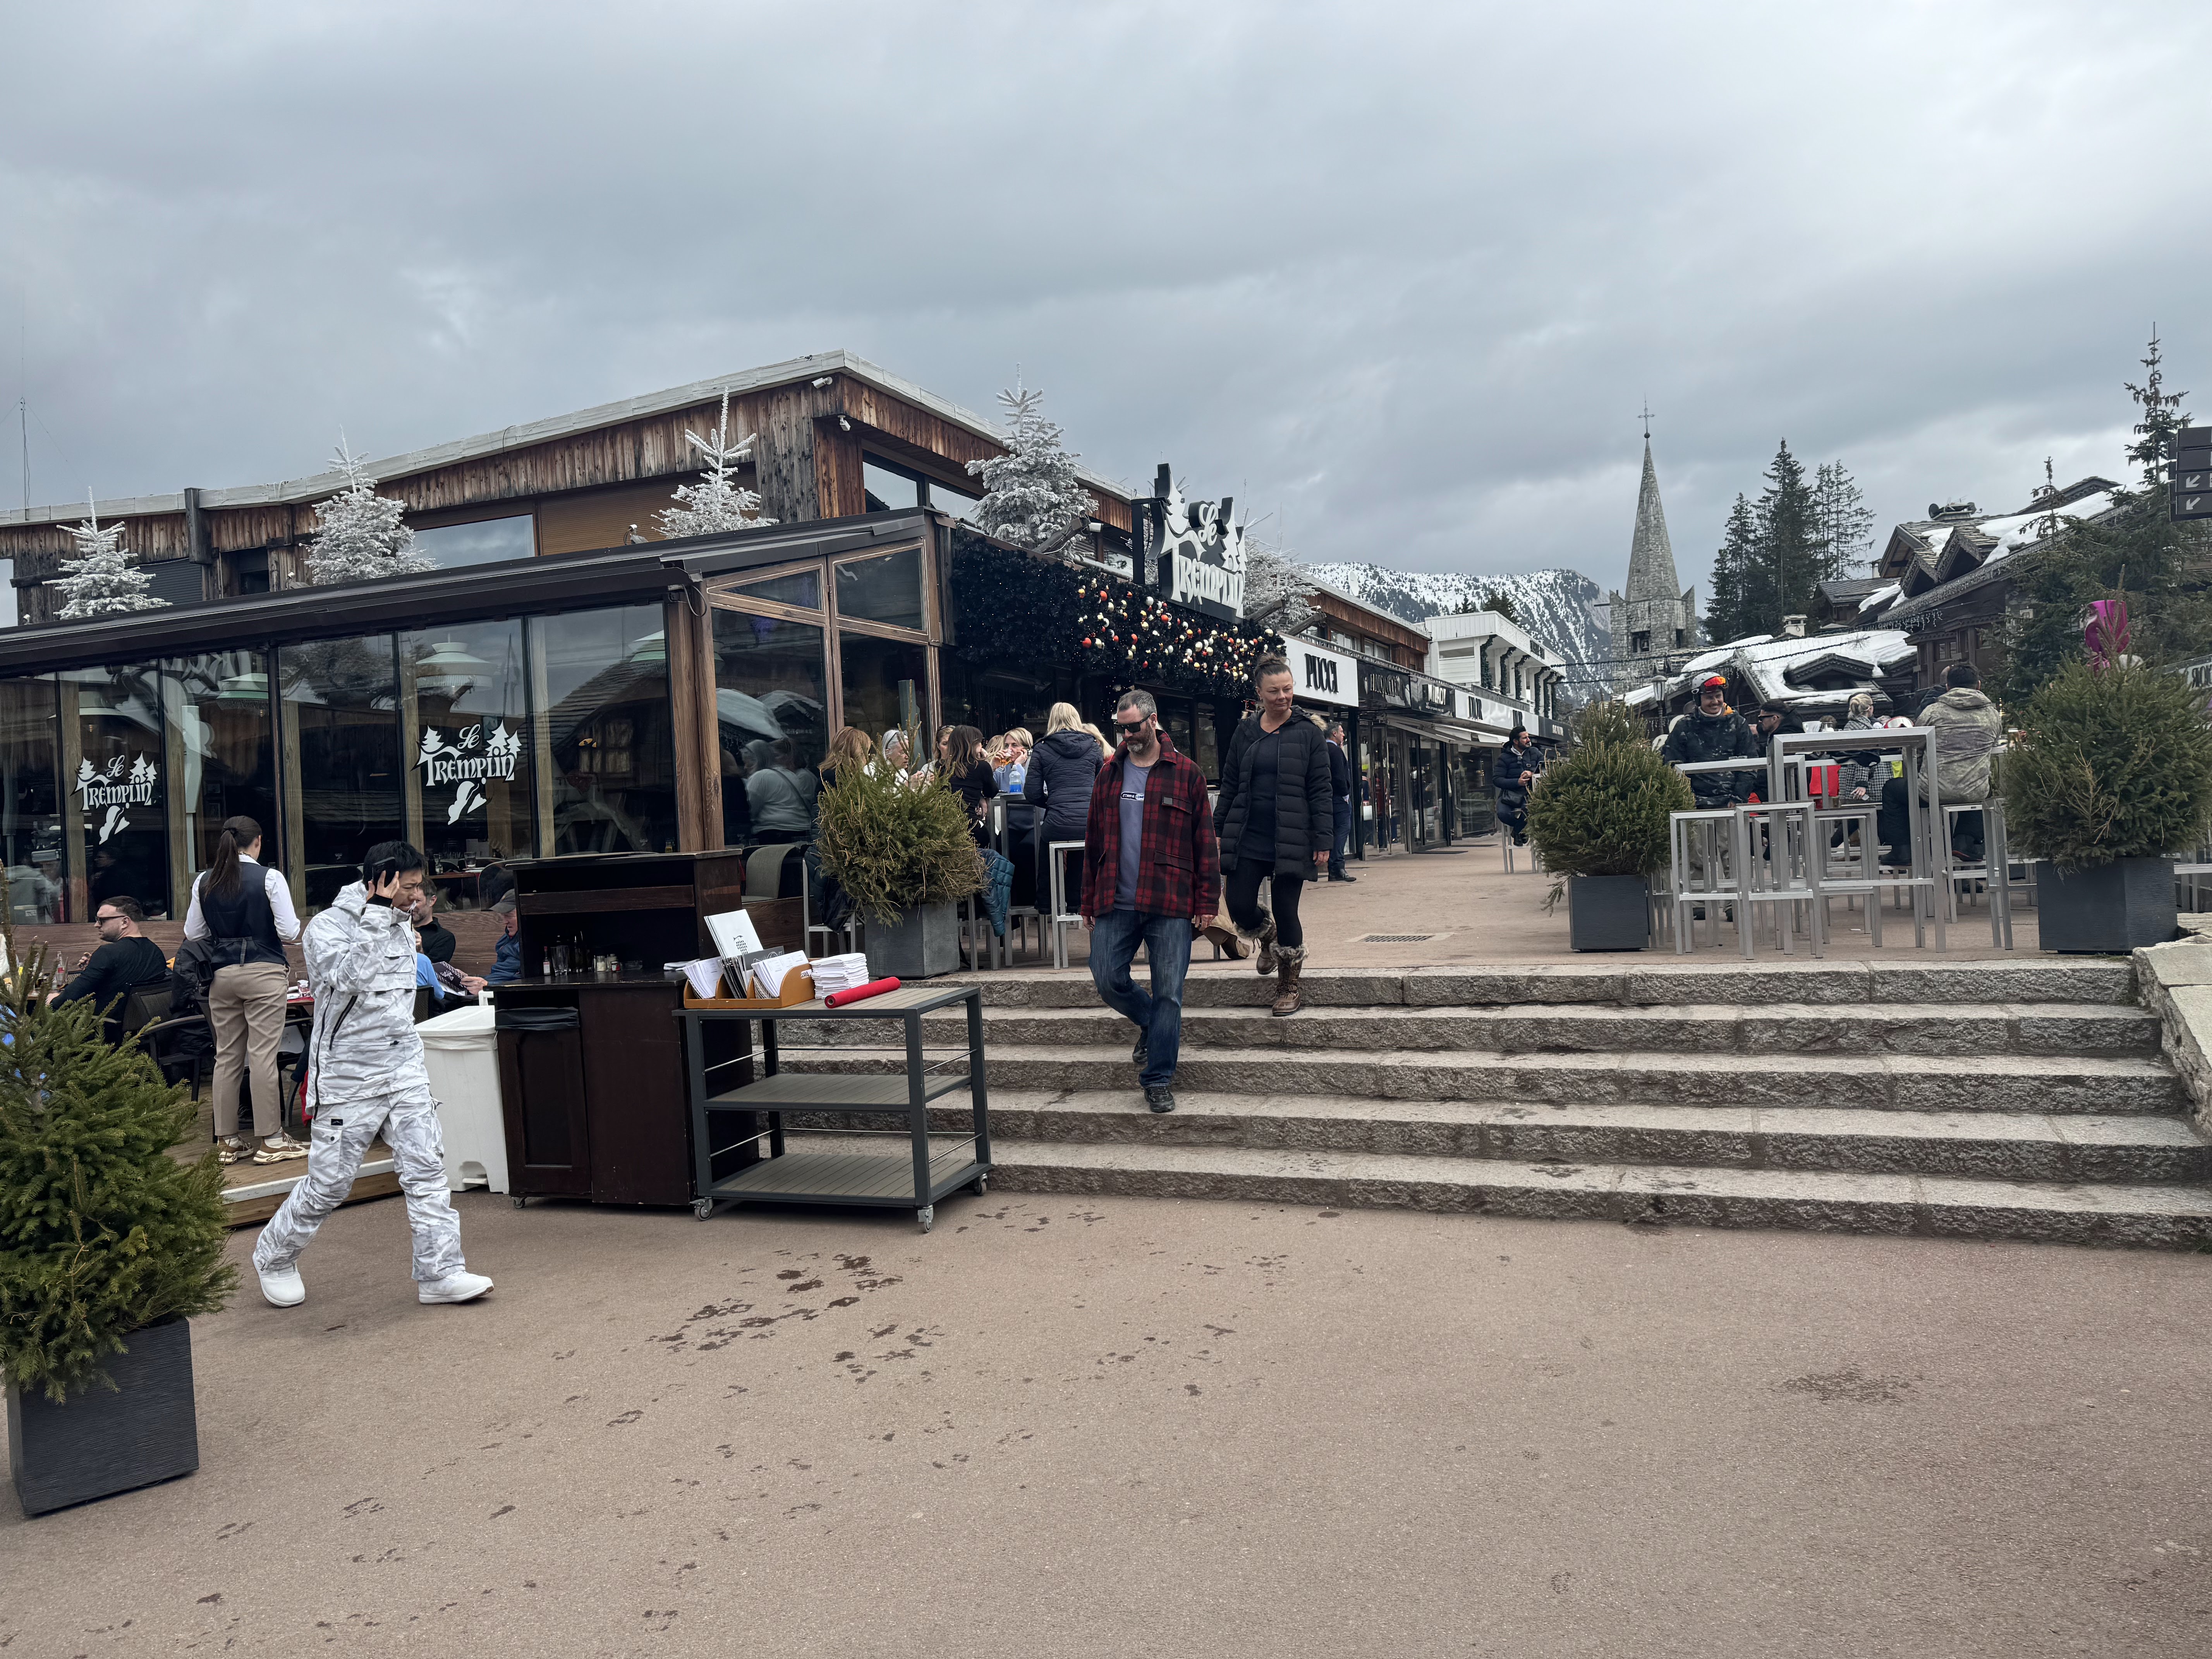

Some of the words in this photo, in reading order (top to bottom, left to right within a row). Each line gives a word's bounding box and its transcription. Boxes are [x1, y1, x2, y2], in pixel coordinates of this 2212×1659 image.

[1198, 504, 1218, 546] Le
[1304, 653, 1339, 694] PUCCI
[457, 724, 481, 749] Le
[106, 755, 125, 777] Le
